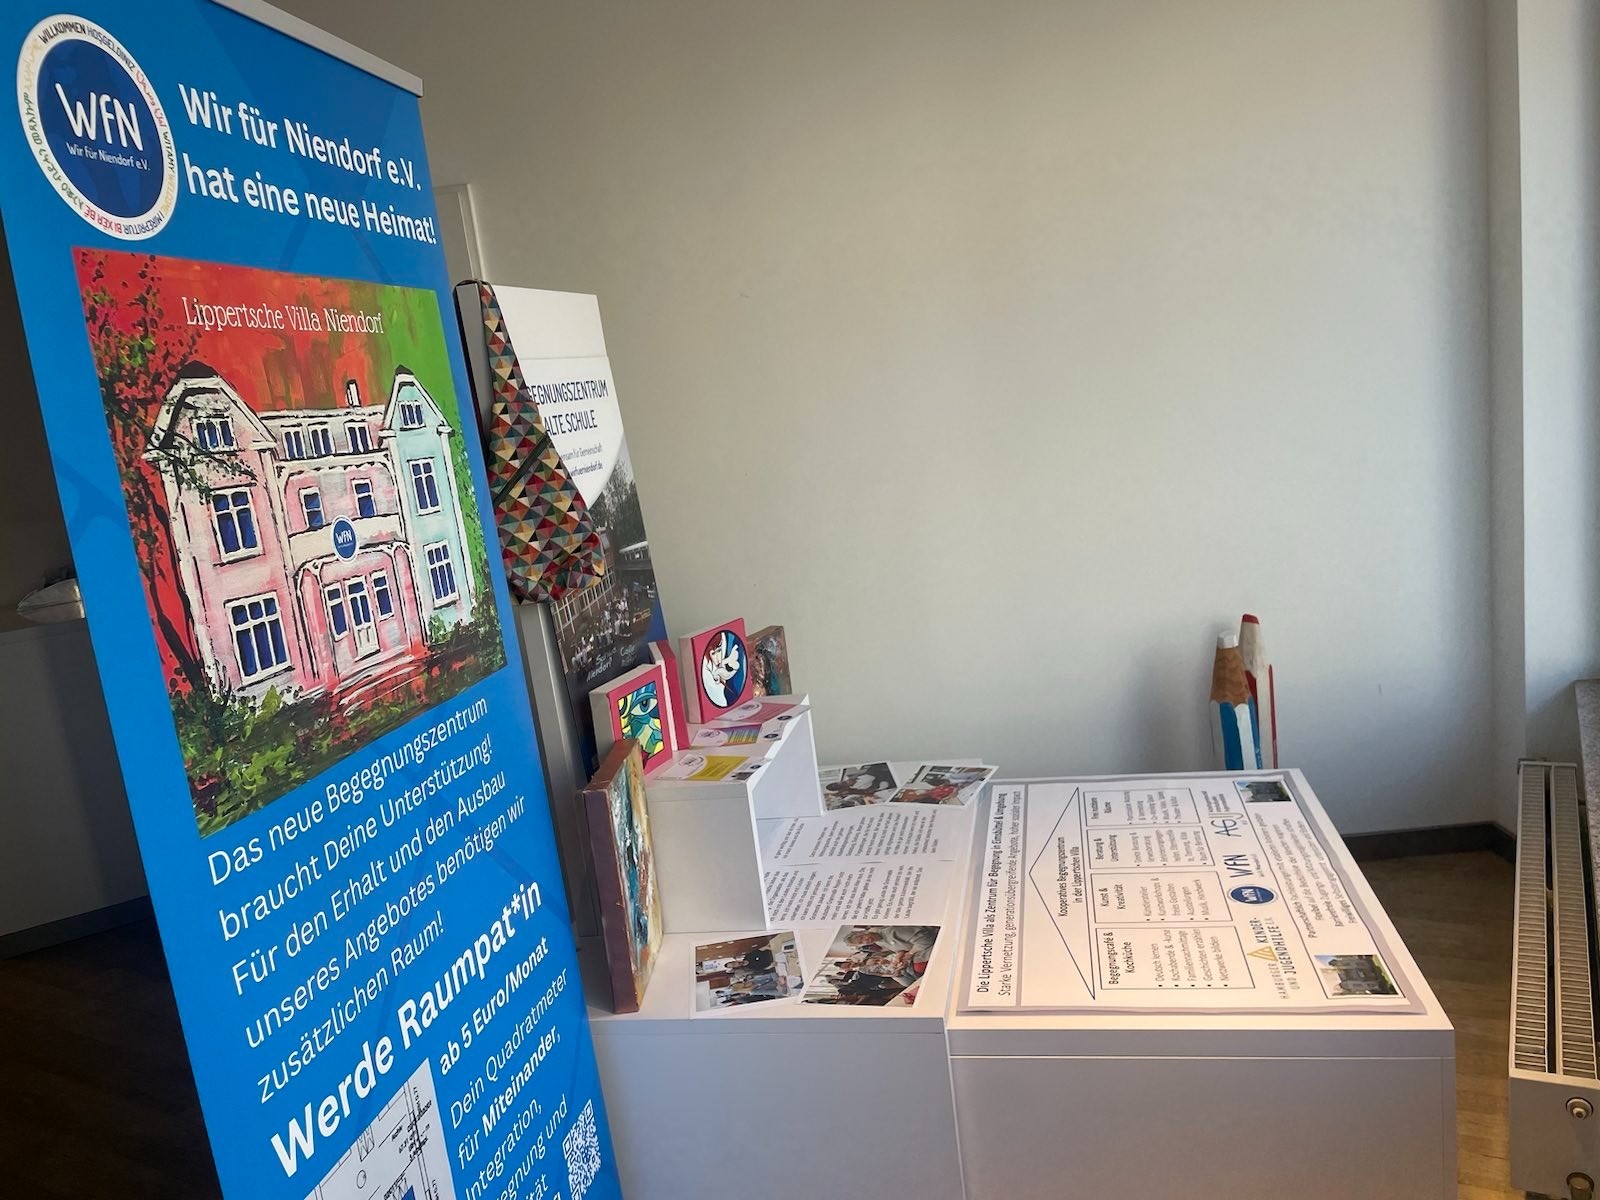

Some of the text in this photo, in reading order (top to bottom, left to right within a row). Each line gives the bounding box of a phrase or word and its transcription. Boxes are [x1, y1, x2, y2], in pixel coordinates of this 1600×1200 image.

[39, 21, 86, 45] WILLKOMMEN
[55, 82, 143, 151] WfN
[162, 131, 176, 174] WITAMY
[178, 83, 232, 135] Wir
[238, 102, 277, 149] für
[284, 117, 382, 179] Niendorf
[387, 157, 421, 191] e.V.
[66, 142, 151, 170] Wir für Niendorf e.V.
[182, 153, 437, 245] hat eine neue Heimat!
[182, 296, 384, 334] Lippertsche Villa Niendorf
[526, 379, 609, 405] EGNUNGSZENTRUM
[544, 410, 598, 436] ALTE SCHULE
[208, 698, 487, 885] Das neue Begegnungszentrum
[994, 793, 1007, 815] Umgebung
[219, 733, 493, 941] braucht Deine Unterstützung!
[990, 820, 1003, 844] Eimsbüttel
[1006, 836, 1020, 858] Angebote,
[987, 850, 1002, 877] Begegnung
[1069, 846, 1080, 855] Villa
[232, 771, 505, 995] Für den Erhalt und den Ausbau
[986, 878, 998, 887] für
[1056, 836, 1070, 916] Kooperatives Begegnungszentrum
[1070, 856, 1084, 886] Lippertschen
[984, 887, 997, 912] Zentrum
[1071, 887, 1082, 896] der
[1099, 892, 1110, 906] Kunst
[1113, 883, 1126, 909] Kreativität
[245, 795, 525, 1048] unseres Angebotes benötigen wir
[982, 924, 994, 936] Villa
[983, 914, 995, 922] als
[1249, 917, 1267, 943] KINDER-
[978, 938, 995, 979] Lippertsche
[1000, 931, 1016, 972] Vernetzung,
[1102, 937, 1121, 984] Begegnungscafé
[1121, 941, 1135, 973] Kochküche
[1151, 943, 1165, 982] Deutsch lernen
[1166, 950, 1180, 982] Kochabende
[1195, 949, 1213, 982] Geschichten
[1207, 936, 1230, 982] Netzwerke bilden
[1269, 925, 1297, 974] JUGENDHILFE
[977, 980, 989, 992] Die
[997, 974, 1012, 995] Starke
[1268, 963, 1289, 999] HAMBURGER
[1286, 975, 1300, 989] UND
[257, 910, 444, 1103] zusätzlichen Raum!
[439, 937, 549, 1076] ab 5 Euro/Monat
[451, 967, 568, 1130] Dein Quadratmeter
[270, 1040, 394, 1178] Werde
[457, 1121, 480, 1170] für
[482, 1025, 560, 1138] Miteinander,
[545, 1093, 568, 1139] und
[466, 1099, 543, 1200] Integration,
